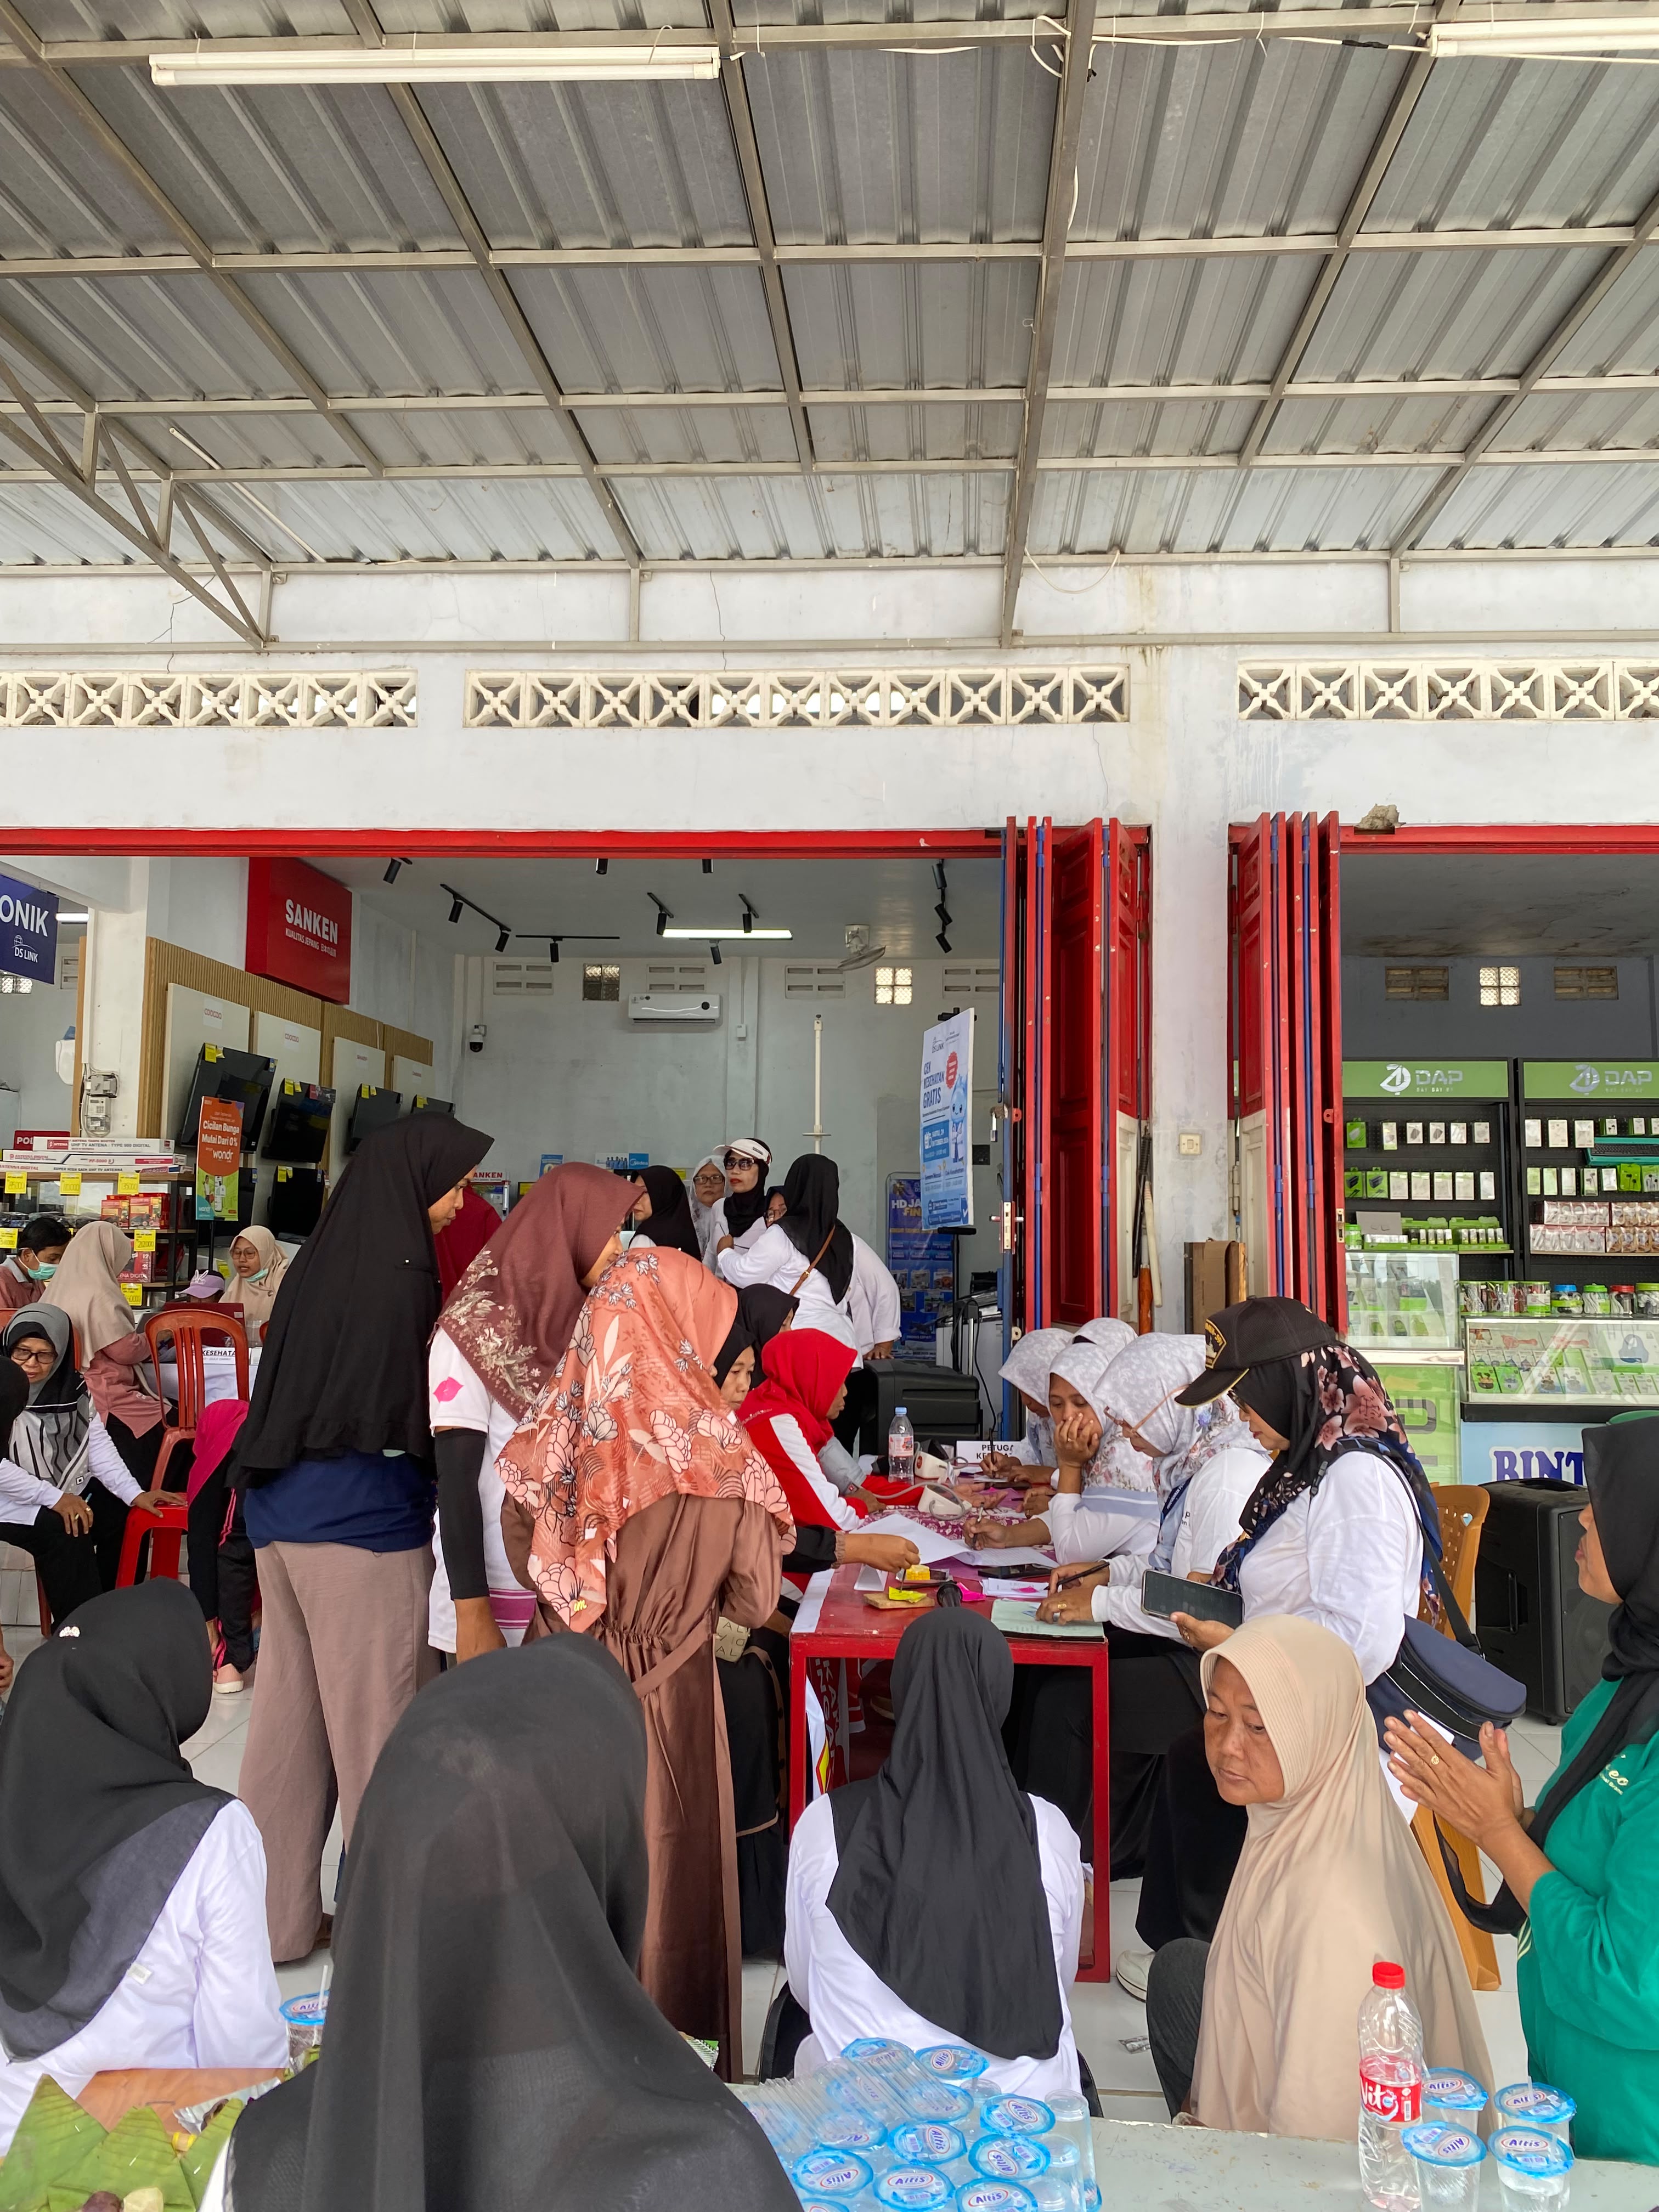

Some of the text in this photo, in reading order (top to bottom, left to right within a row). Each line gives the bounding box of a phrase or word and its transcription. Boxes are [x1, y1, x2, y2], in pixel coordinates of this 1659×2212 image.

[285, 899, 338, 945] SANKEN
[285, 928, 319, 950] KUALITAS JEPANG
[14, 947, 38, 963] DS LINK
[923, 1070, 945, 1090] KESEHATAN
[1415, 1070, 1463, 1085] DAP
[1605, 1070, 1652, 1086] DAP
[923, 1087, 941, 1109] GRATIS
[203, 1120, 240, 1135] Cicilan Bunga
[202, 1133, 238, 1147] Mulai Dari 0%
[213, 1149, 234, 1160] wondr
[935, 2052, 949, 2067] Altis
[1429, 2081, 1455, 2090] Altis
[1513, 2094, 1539, 2104] Alts
[1012, 2103, 1033, 2121] Altis
[932, 2129, 944, 2150] Altis
[1442, 2138, 1465, 2154] Altis
[1509, 2139, 1540, 2147] Altis
[994, 2154, 1013, 2172] Altis
[826, 2171, 851, 2185] Altis
[895, 2176, 926, 2186] Altis
[975, 2192, 1003, 2204] Altis
